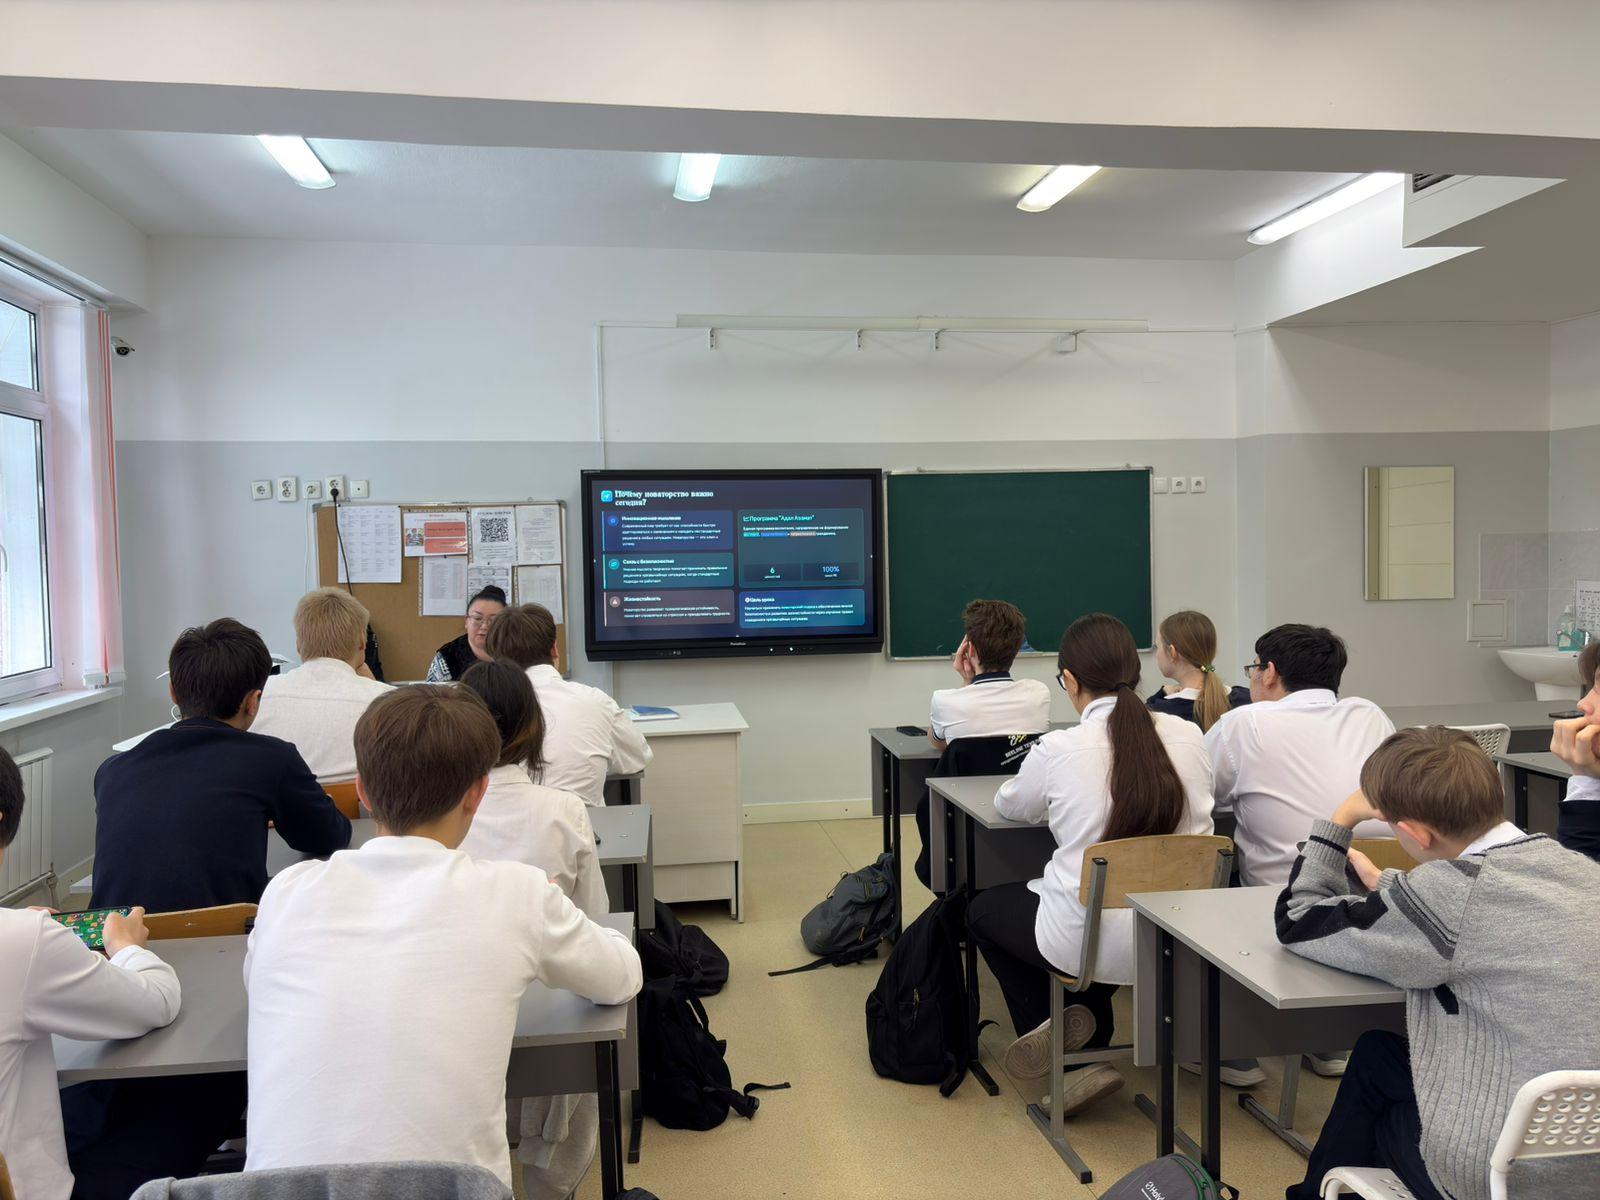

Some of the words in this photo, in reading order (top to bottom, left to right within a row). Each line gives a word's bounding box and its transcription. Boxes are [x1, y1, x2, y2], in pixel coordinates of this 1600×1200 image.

[615, 490, 643, 499] Почему
[645, 491, 689, 499] новаторство
[615, 498, 647, 506] сегодня?
